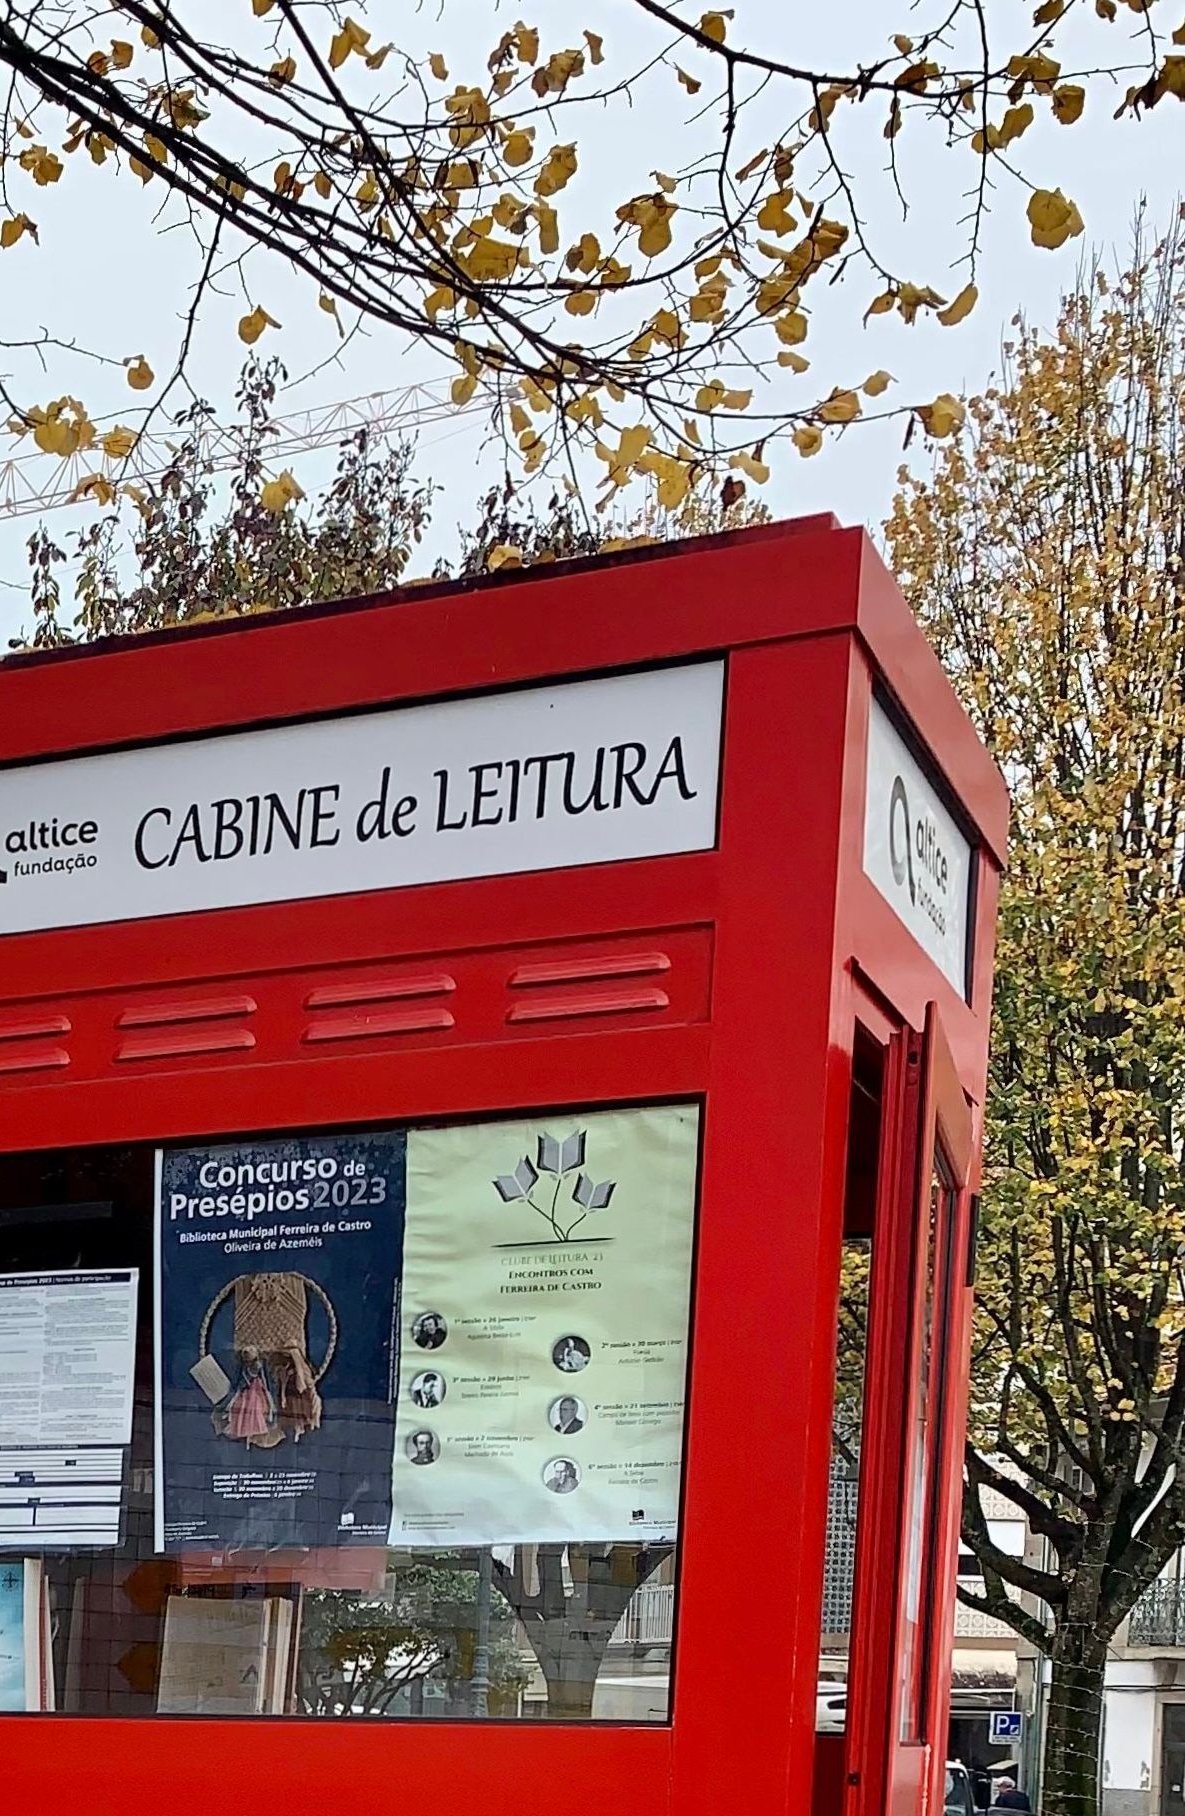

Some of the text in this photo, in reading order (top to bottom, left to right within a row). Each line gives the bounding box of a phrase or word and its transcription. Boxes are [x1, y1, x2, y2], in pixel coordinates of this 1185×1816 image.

[135, 736, 697, 870] CABINE de LEITURA
[5, 817, 99, 853] altice
[13, 853, 98, 878] fundação
[916, 818, 948, 895] altice
[199, 1158, 365, 1188] Concurso de
[170, 1177, 387, 1221] Presépios 2023
[180, 1220, 372, 1244] Biblioteca Municipal Ferreira de Castro
[224, 1236, 323, 1254] Oliveira de Azeméis
[500, 1284, 545, 1294] FERREIRA
[562, 1281, 602, 1291] CASTRO
[995, 1715, 1010, 1735] P
